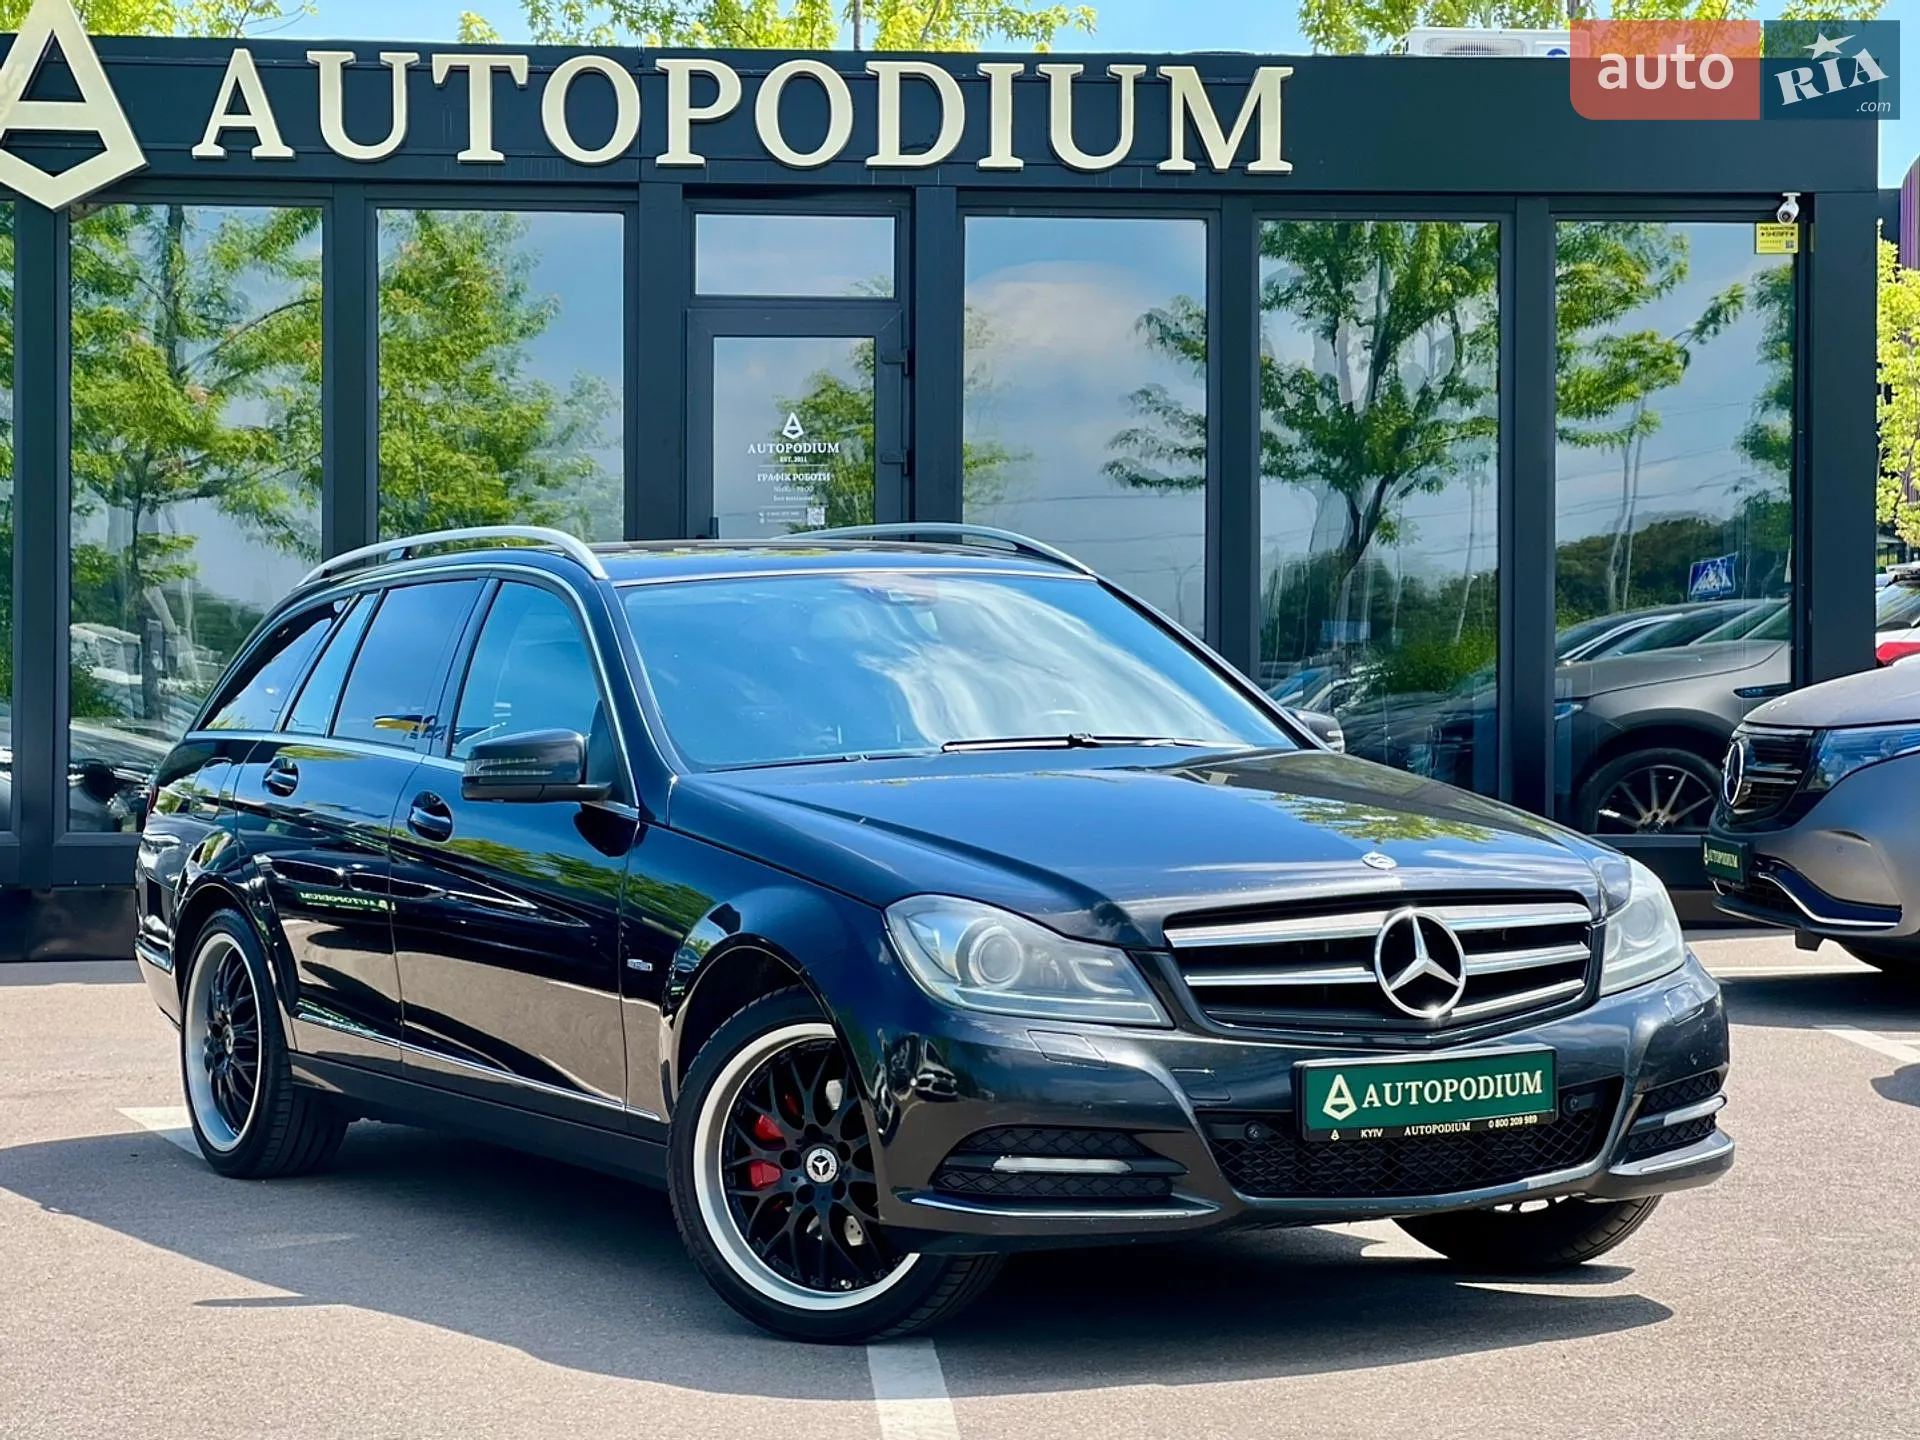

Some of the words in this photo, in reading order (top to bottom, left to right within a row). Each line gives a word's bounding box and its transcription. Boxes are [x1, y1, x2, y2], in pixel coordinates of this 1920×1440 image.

[192, 48, 1294, 174] AUTOPODIUM
[747, 442, 840, 454] AUTOPODIUM
[1362, 1070, 1542, 1109] AUTOPODIUM
[1360, 1128, 1384, 1139] KYIV
[1404, 1122, 1471, 1136] AUTOPODIUM
